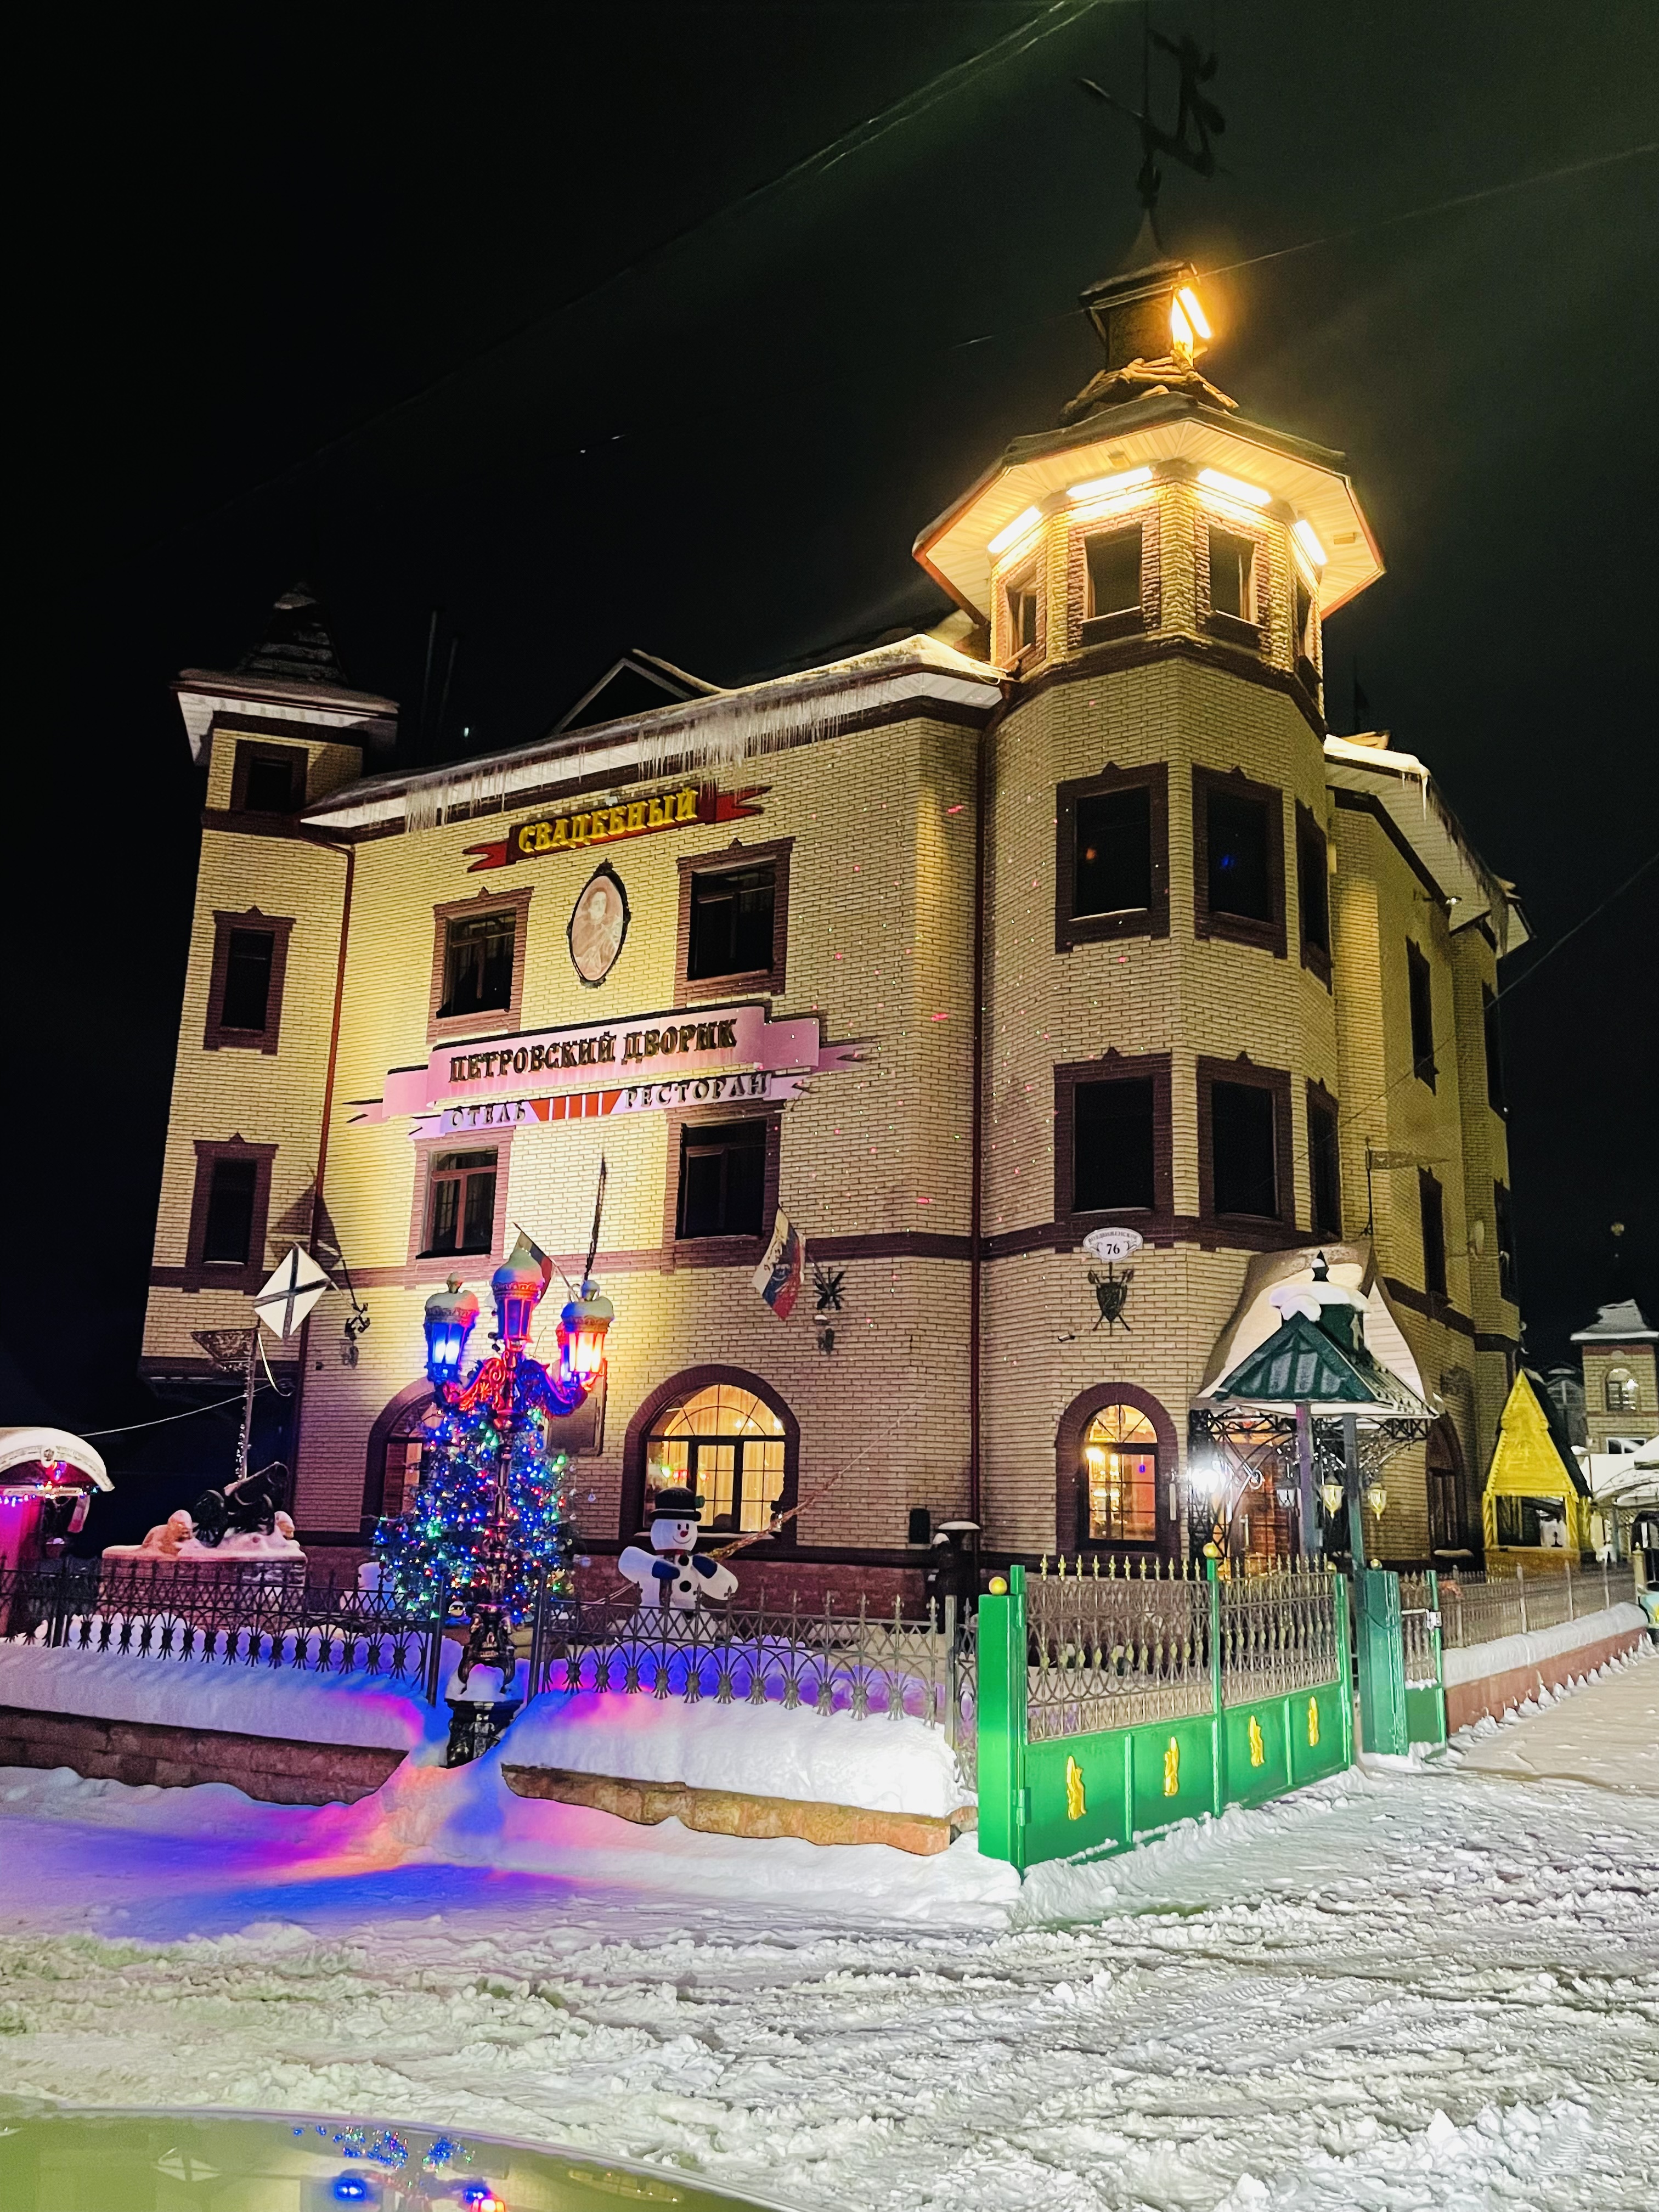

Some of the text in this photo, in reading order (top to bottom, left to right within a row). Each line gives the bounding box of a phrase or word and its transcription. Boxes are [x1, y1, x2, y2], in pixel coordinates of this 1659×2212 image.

[518, 787, 698, 853] СВАДЕБНЫЙ
[448, 1018, 738, 1082] ПЕТРОВСКИЙ ДВОРИК
[450, 1073, 769, 1128] ОТЕЛЬ РЕСТОРАН
[1107, 1243, 1120, 1255] 76
